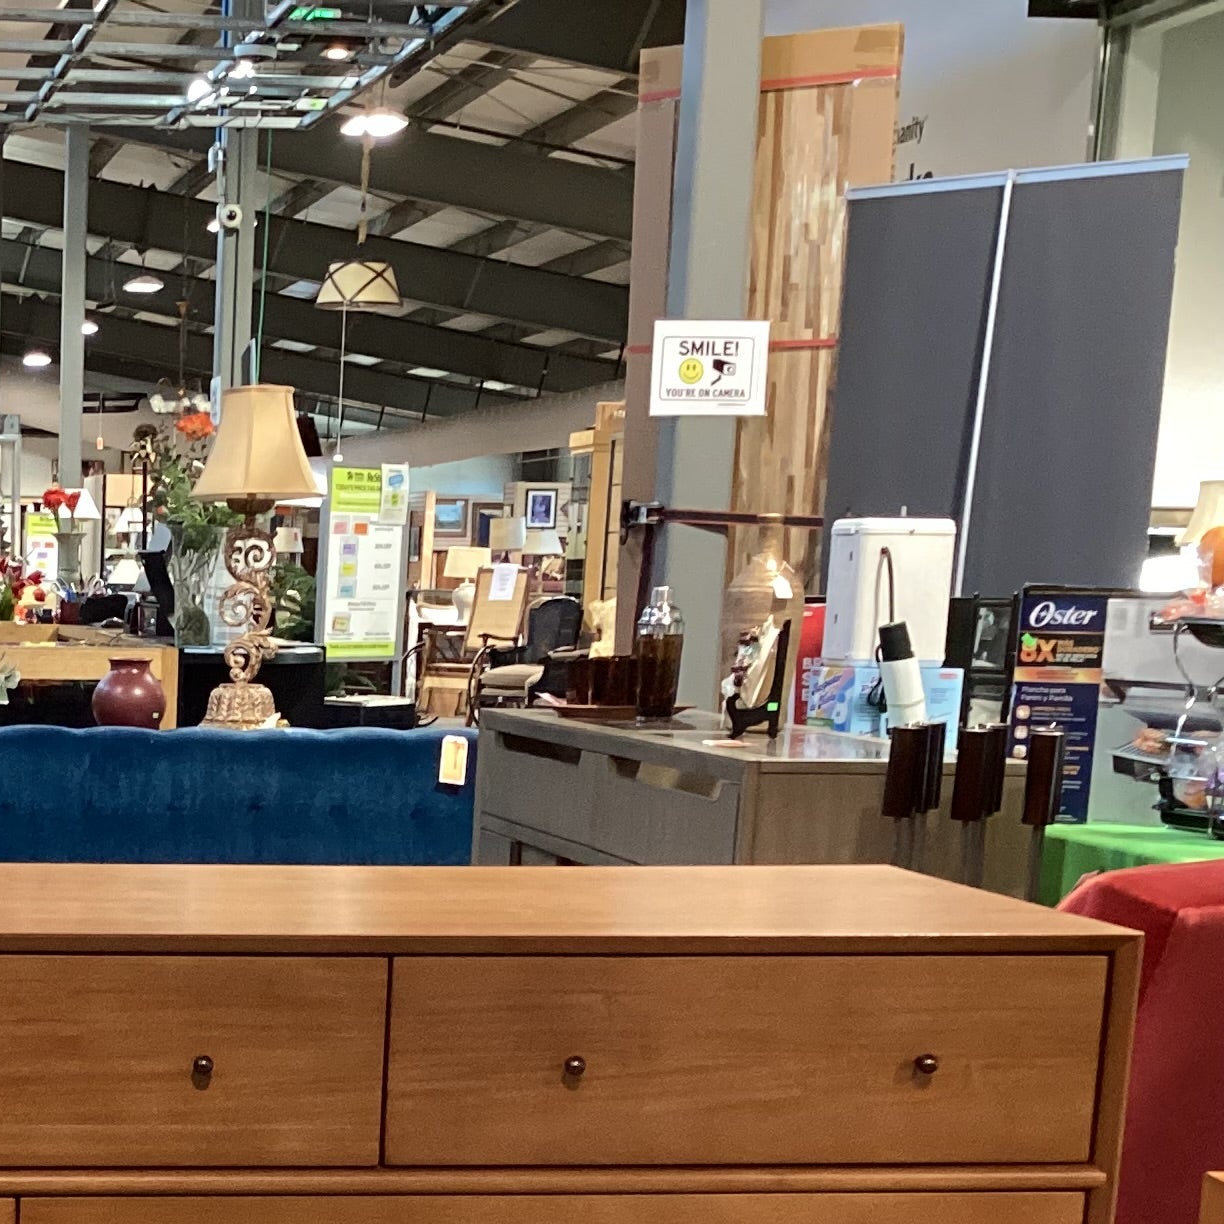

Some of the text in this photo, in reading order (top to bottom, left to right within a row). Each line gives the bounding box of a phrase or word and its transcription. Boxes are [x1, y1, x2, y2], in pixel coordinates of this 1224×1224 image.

[895, 115, 926, 144] anity
[679, 340, 739, 357] SMILE!
[666, 388, 746, 398] YOU'RE ON CAMERA
[1029, 601, 1098, 628] Oster
